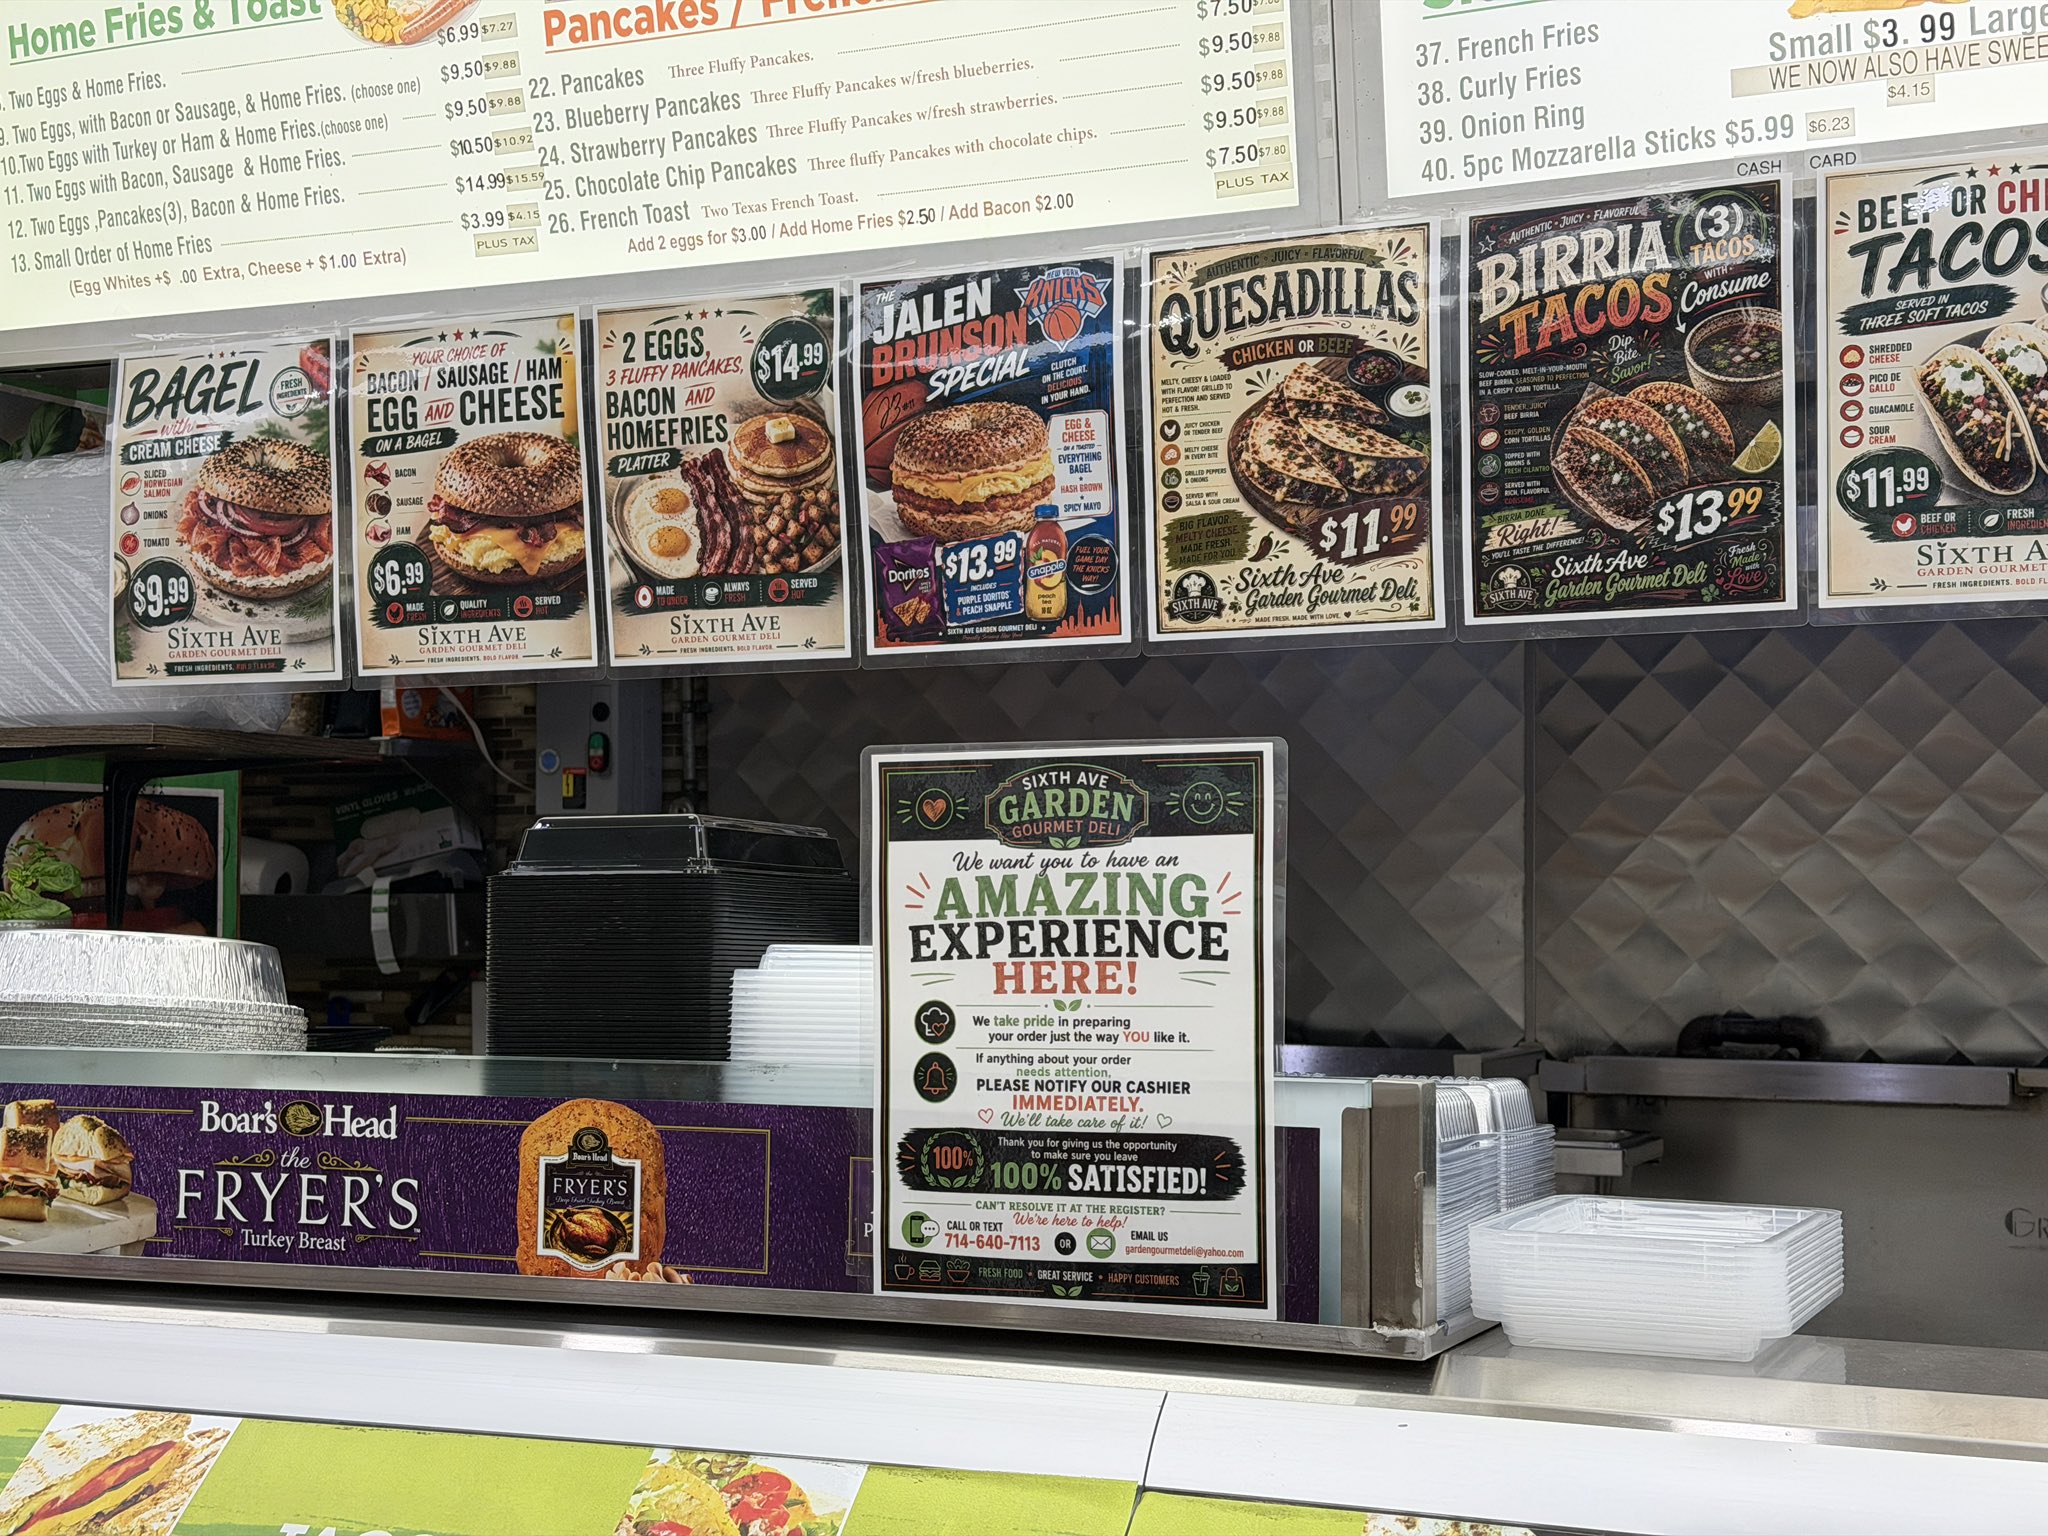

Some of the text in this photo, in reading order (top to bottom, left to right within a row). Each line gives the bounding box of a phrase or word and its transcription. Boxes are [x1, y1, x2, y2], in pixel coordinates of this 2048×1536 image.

[8, 0, 215, 59] Home Fries &
[437, 22, 513, 47] $6.99 $7.27
[543, 0, 719, 46] Pancakes
[1199, 32, 1280, 58] $9.50 $9.88
[1416, 22, 1599, 68] 37. French Fries
[1769, 23, 1851, 61] Small
[529, 50, 814, 99] 22. Pancakes Three Fluffy Pancakes.
[1769, 65, 1801, 90] WE
[1808, 58, 1858, 86] NOW
[1864, 49, 1918, 78] ALSO
[1926, 43, 1981, 72] HAVE
[9, 71, 166, 110] Two Eggs & Home Fries.
[533, 58, 1034, 133] 23. Blueberry Pancakes Three Fluffy Pancakes w/fresh blueberries.
[1418, 65, 1581, 106] 38. Curly Fries
[1888, 82, 1930, 99] $4.15
[1419, 105, 1585, 145] 39. Onion Ring
[1809, 117, 1850, 133] $6.23
[1206, 144, 1286, 169] $7.50 $7.80
[1421, 114, 1794, 182] 40. 5pc Mozzarella Sticks $5.99
[1810, 152, 1856, 169] CARD
[455, 172, 544, 194] $14.99 $15.59
[1217, 172, 1289, 190] PLUS TAX
[1737, 160, 1782, 176] CASH
[461, 210, 539, 231] $3.99 $4.15
[11, 235, 212, 273] 13. Small Order of Home Fries
[477, 236, 535, 249] PLUS TAX
[1476, 219, 1672, 323] BIRRIA
[1027, 276, 1101, 308] KNICKS
[1680, 272, 1772, 313] Consume
[873, 277, 991, 345] JALEN
[1158, 266, 1420, 358] QUESADILLAS
[1500, 271, 1672, 359] TACOS
[623, 326, 710, 363] 2 EGGS,
[872, 307, 1028, 387] BRUNSON
[1232, 338, 1353, 366] CHICKEN OR BEEF
[1869, 341, 1912, 355] SHREDDED
[1869, 352, 1900, 364] CHEESE
[758, 342, 822, 384] $14.99
[927, 348, 1031, 402] SPECIAL
[123, 358, 264, 430] BAGEL
[368, 384, 565, 432] EGG AND CHEESE
[606, 386, 715, 420] BACON AND
[1869, 403, 1915, 414] GUACAMOLE
[608, 414, 729, 451] HOMEFRIES
[1062, 429, 1095, 442] CHEESE
[1065, 419, 1091, 431] EGG &
[129, 436, 221, 461] CREAM CHEESE
[617, 453, 670, 473] PLATTER
[1847, 467, 1929, 508] $11.99
[1657, 486, 1762, 542] $13.99
[1320, 504, 1416, 559] $11.99
[373, 559, 424, 597] $6.99
[888, 566, 929, 583] Doritos
[946, 541, 1016, 584] $13.99
[133, 574, 189, 618] $9.99
[1022, 771, 1108, 790] SIXTH AVE
[336, 799, 360, 815] VINYL
[362, 790, 398, 807] GLOVES
[1000, 788, 1136, 824] GARDEN
[1012, 820, 1120, 838] GOURMET DELI
[953, 851, 1179, 876] We want you to have an
[934, 872, 1209, 920] AMAZING
[909, 920, 1229, 962] EXPERIENCE
[993, 961, 1137, 996] HERE!
[973, 1015, 1131, 1029] We take pride in preparing
[977, 1079, 1190, 1095] PLEASE NOTIFY OUR CASHIER
[1012, 1095, 1144, 1112] IMMEDIATELY.
[200, 1101, 397, 1140] Boar's Head
[280, 1147, 311, 1169] the
[553, 1177, 628, 1195] FRYER'S
[991, 1162, 1207, 1195] 100% SATISFIED!
[176, 1168, 419, 1230] FRYER'S
[241, 1229, 346, 1253] Turkey Breast
[945, 1233, 1041, 1251] 714-640-7113
[947, 1220, 1003, 1232] CALL OR TEXT
[1131, 1230, 1168, 1241] EMAIL US
[1125, 1244, 1244, 1259] gardengourmetdeli@yahoo.com
